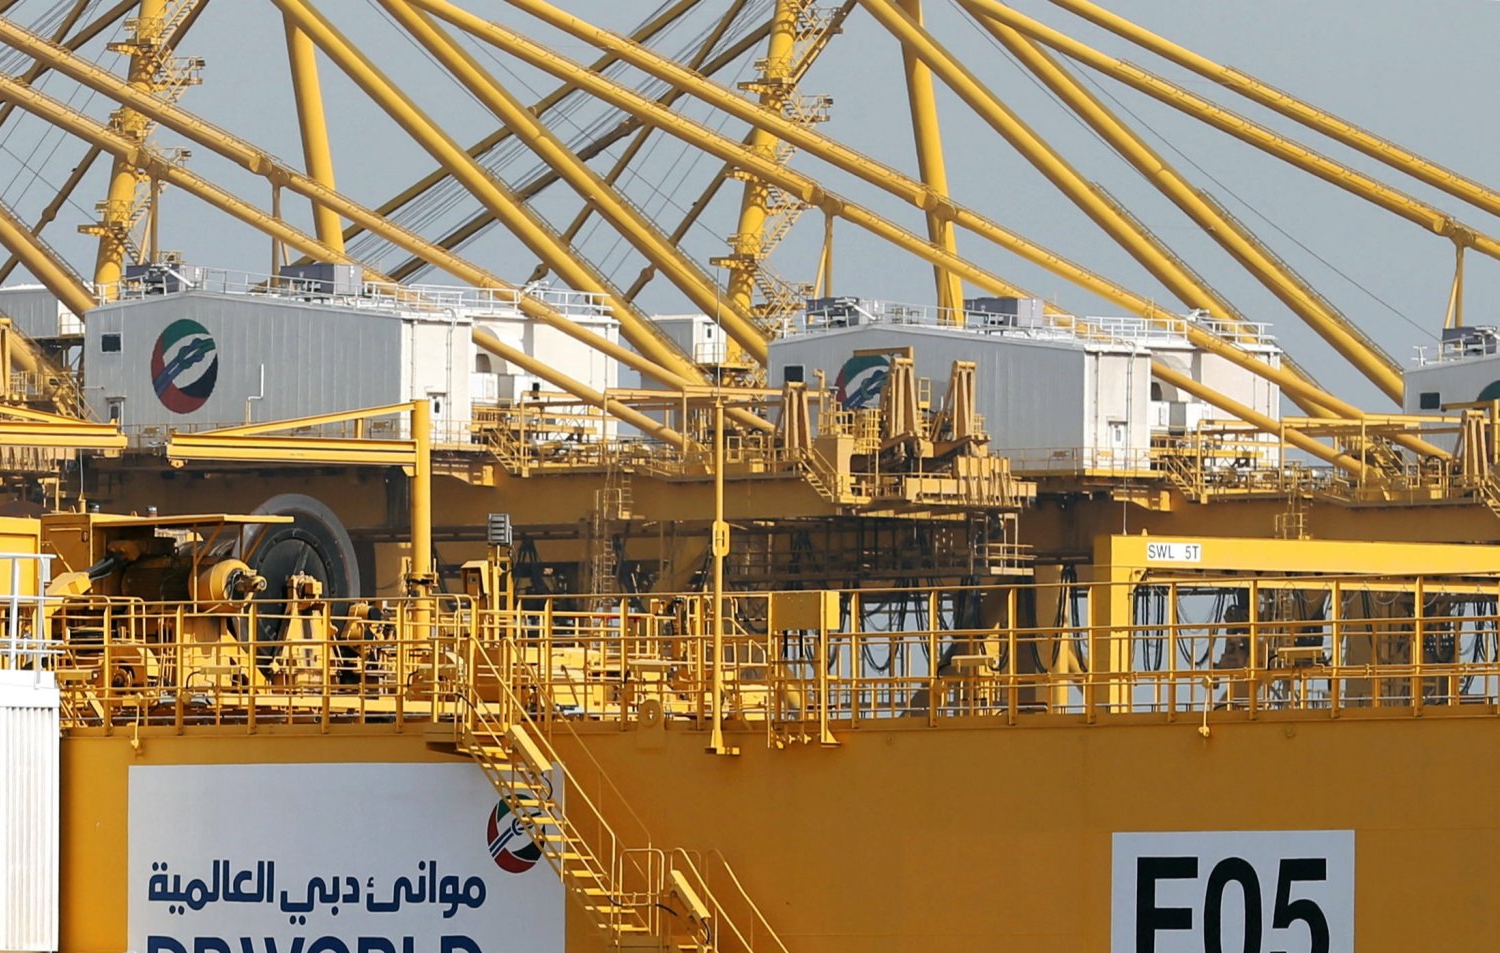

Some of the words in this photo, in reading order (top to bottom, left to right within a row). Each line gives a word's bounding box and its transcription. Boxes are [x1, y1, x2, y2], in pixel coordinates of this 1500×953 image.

[1148, 544, 1175, 559] SWL
[1185, 545, 1199, 560] 5T
[148, 859, 275, 916] العالمية
[280, 875, 360, 926] دبي
[366, 860, 486, 919] موانئ
